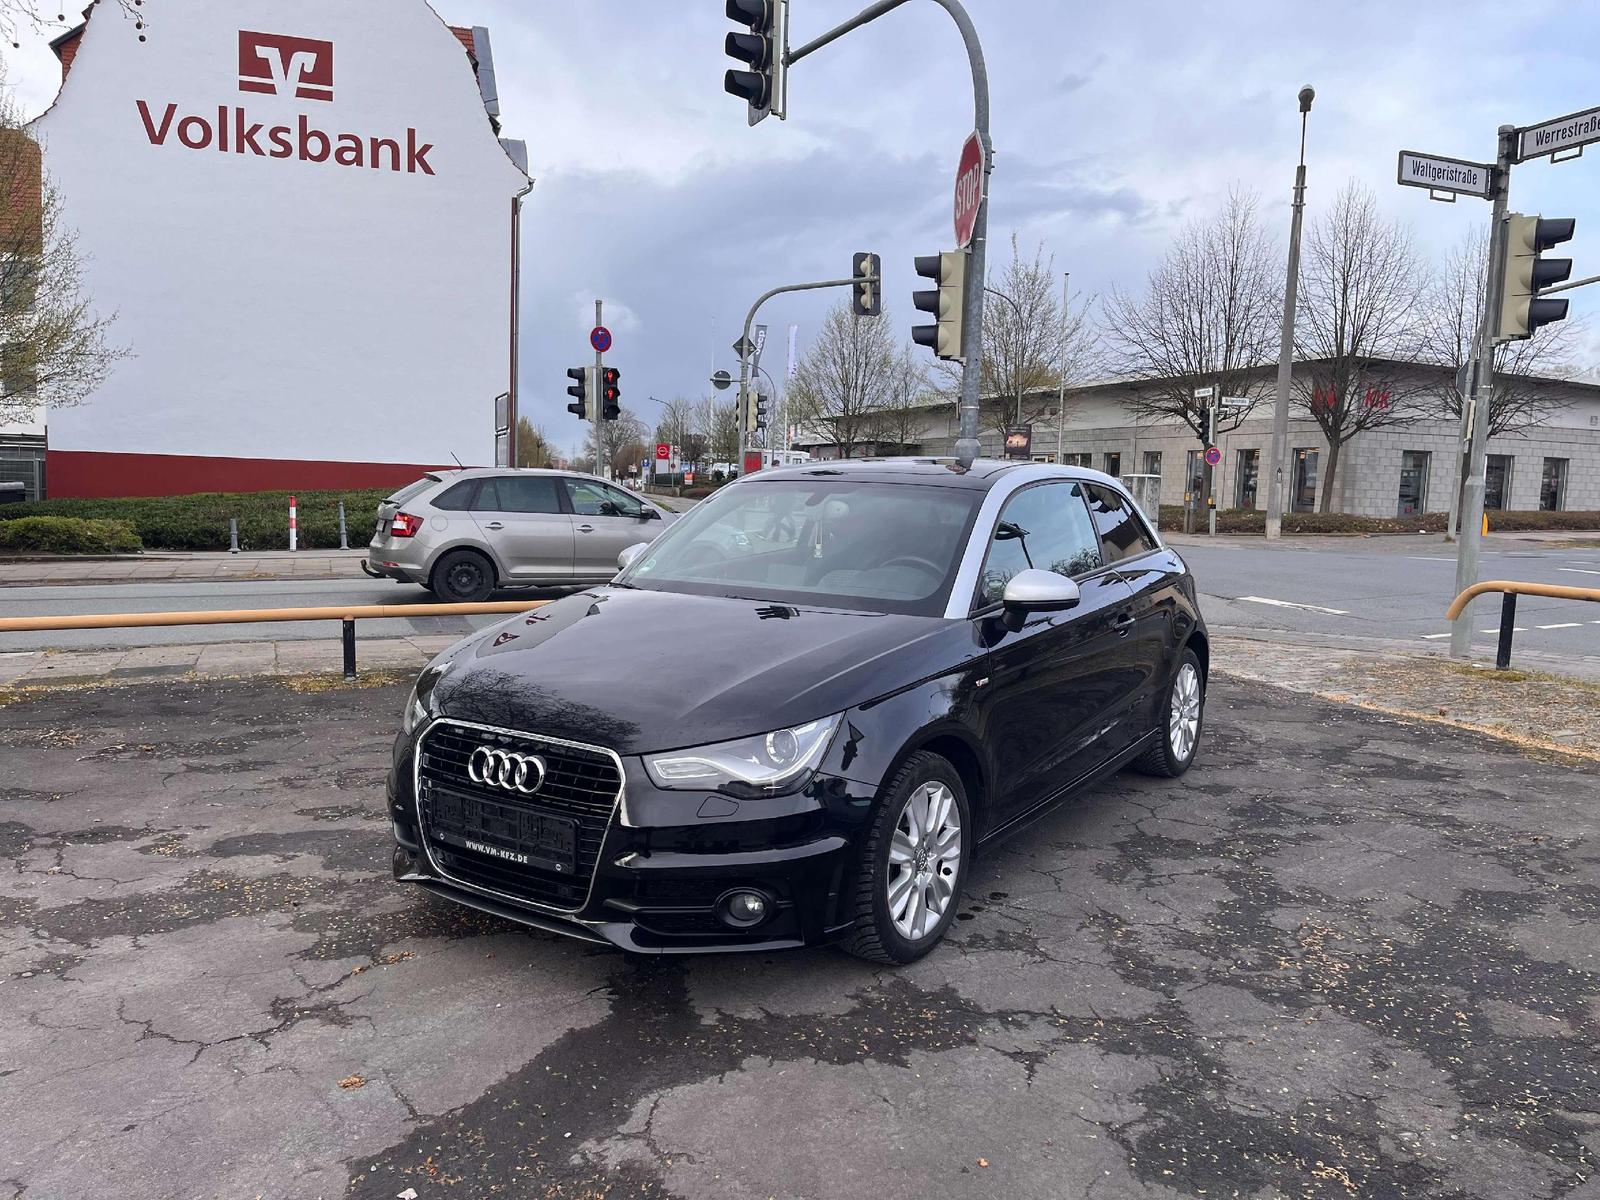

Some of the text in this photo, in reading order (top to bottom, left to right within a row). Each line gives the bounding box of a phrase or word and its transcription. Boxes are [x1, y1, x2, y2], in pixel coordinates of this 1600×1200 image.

[136, 99, 436, 176] Volksbank
[955, 162, 980, 220] STOP
[1412, 159, 1478, 185] Waltgeristraße
[465, 840, 528, 864] WWW.VM-KFZ.DE
